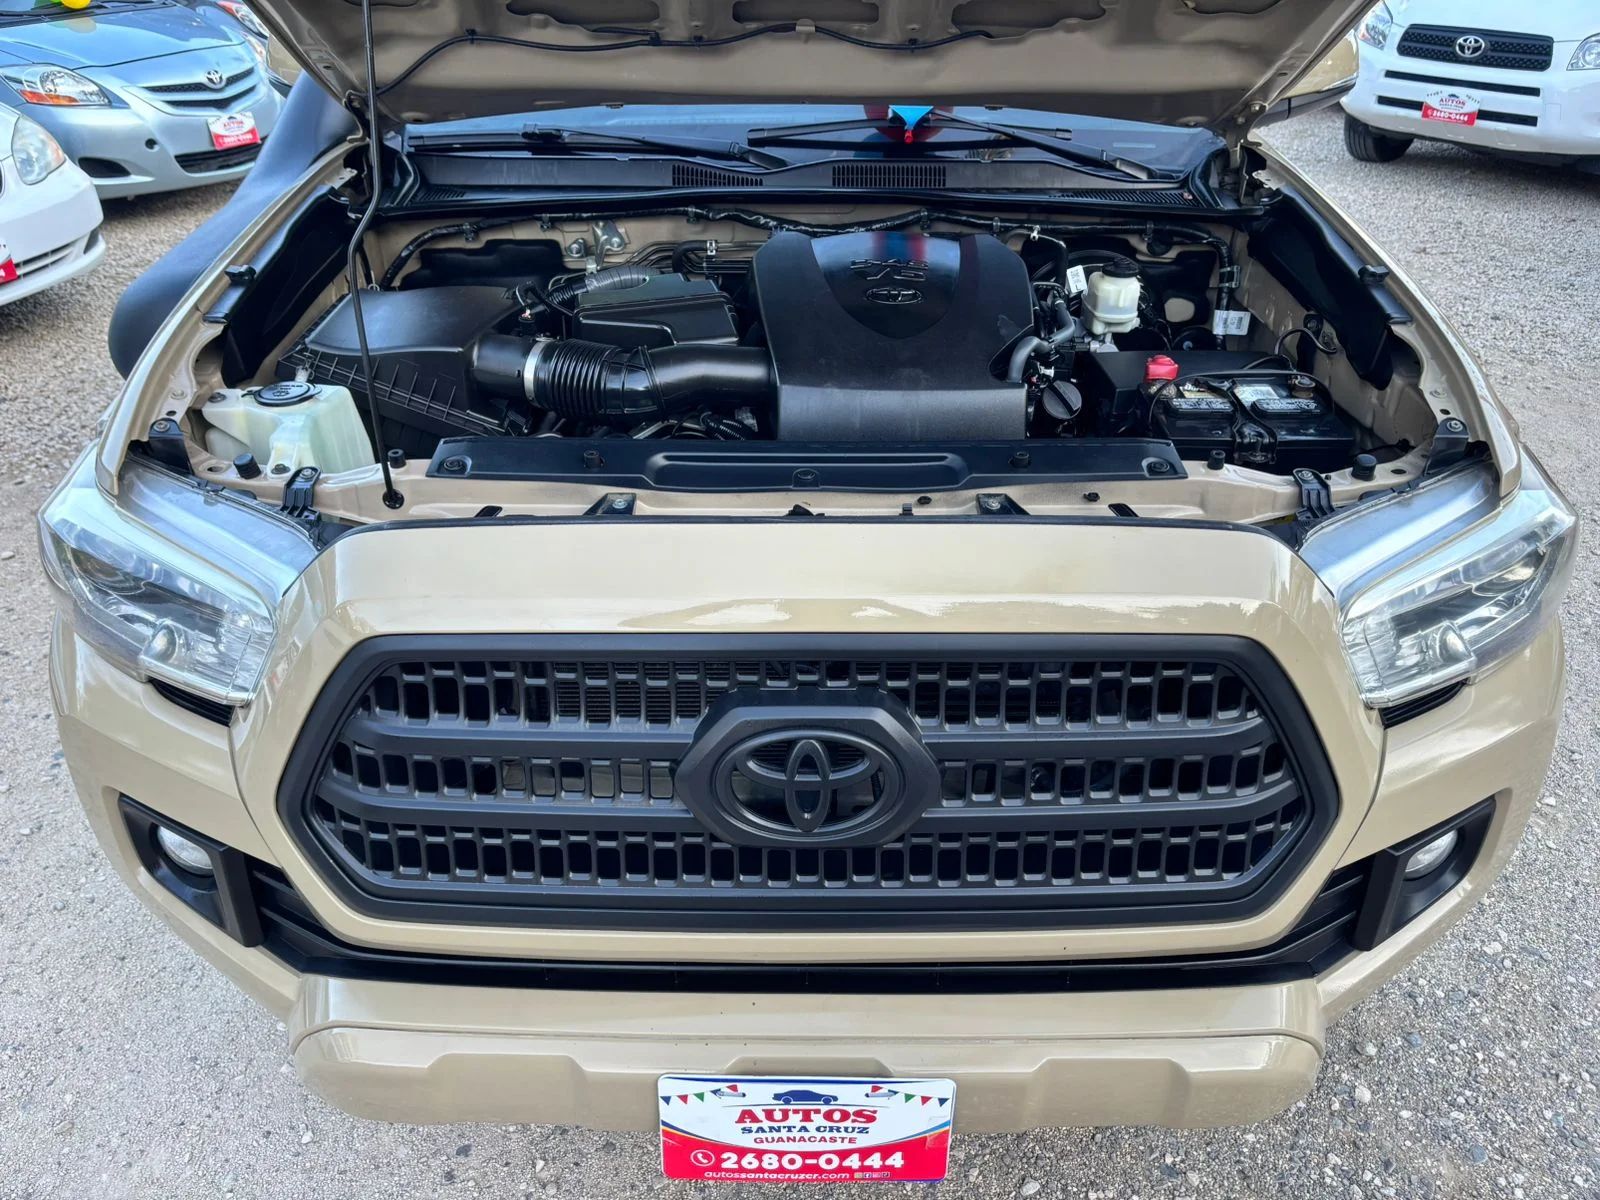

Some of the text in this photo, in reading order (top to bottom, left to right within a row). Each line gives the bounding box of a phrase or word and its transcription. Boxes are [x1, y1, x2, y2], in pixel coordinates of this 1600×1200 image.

[735, 1108, 878, 1124] AUTOS
[740, 1125, 870, 1135] SANTA CRUZ
[753, 1136, 858, 1145] GUANACASTE
[720, 1151, 905, 1170] 2680-0444
[704, 1171, 850, 1180] autossantacruzcr.com
